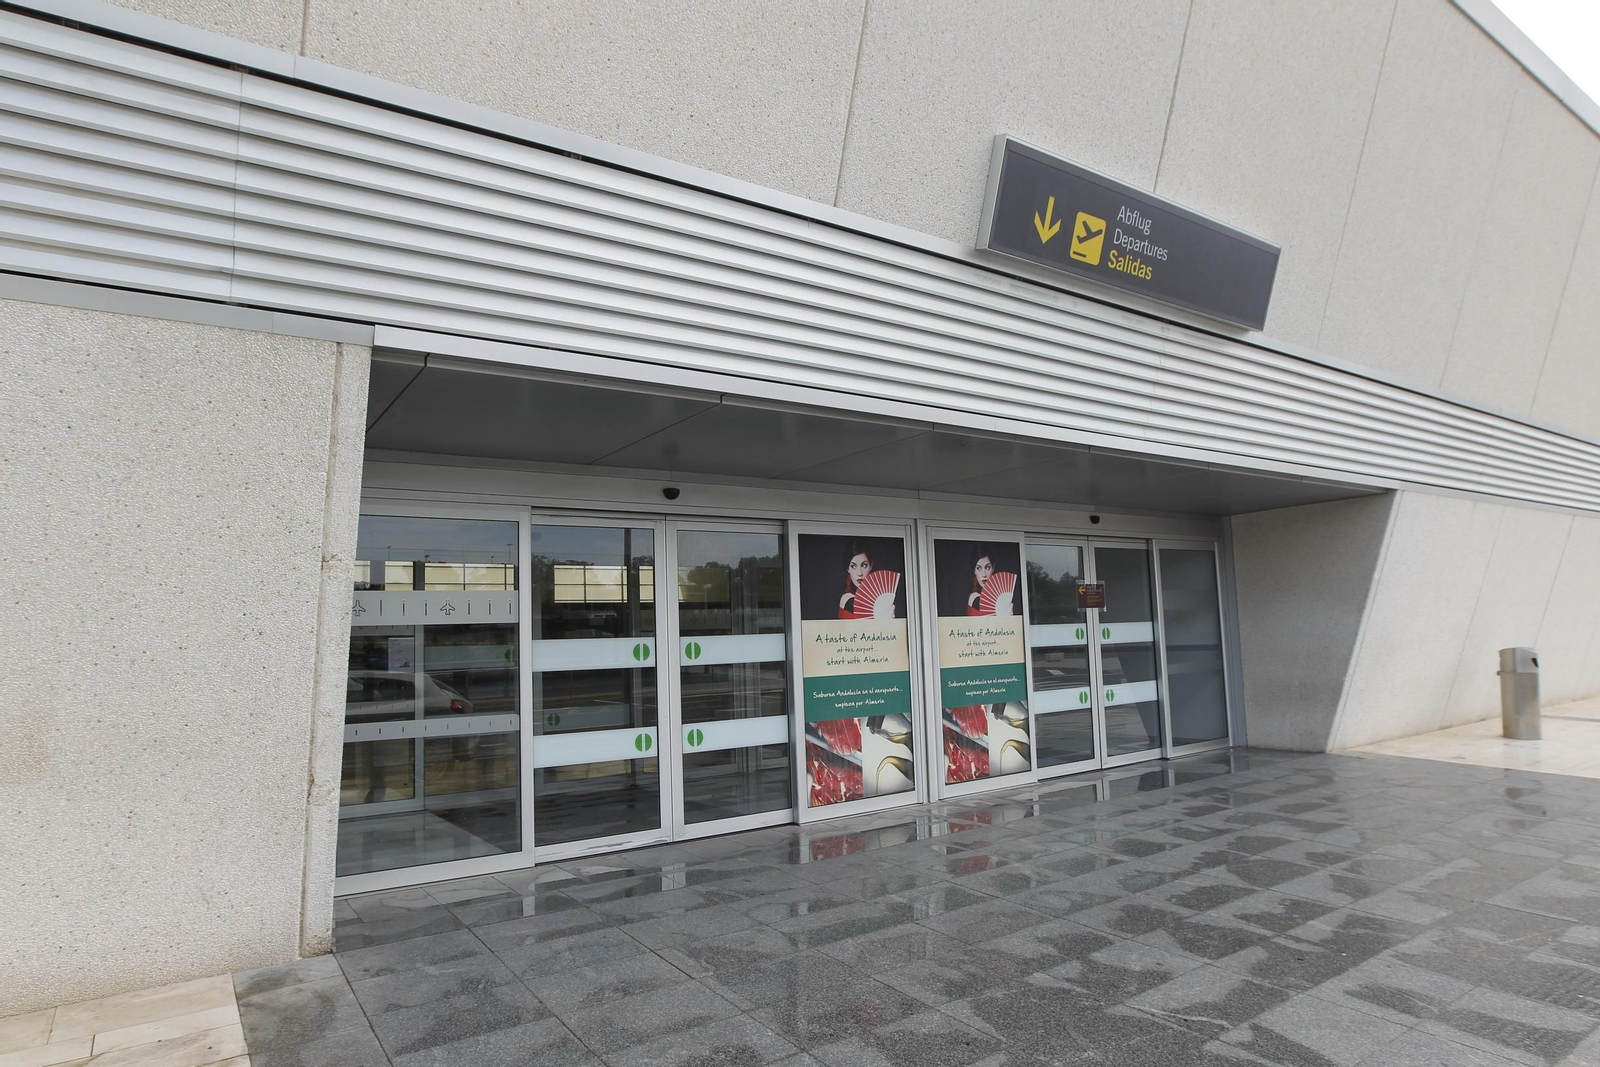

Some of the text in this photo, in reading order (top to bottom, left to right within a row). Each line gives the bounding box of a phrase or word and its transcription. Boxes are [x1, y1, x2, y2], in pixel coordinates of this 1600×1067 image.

[1117, 205, 1152, 235] Abflug
[1113, 228, 1168, 261] Departures
[1108, 249, 1153, 280] Salidas
[815, 631, 897, 644] A taste of Andalusia
[949, 627, 1015, 638] A taste of Andalusia
[845, 645, 855, 653] the
[958, 649, 974, 658] start
[975, 649, 986, 657] with
[826, 656, 845, 666] start
[847, 655, 861, 665] with
[948, 680, 966, 688] Saborea
[813, 690, 836, 699] Saborea
[834, 700, 855, 709] empieza
[856, 700, 864, 708] por
